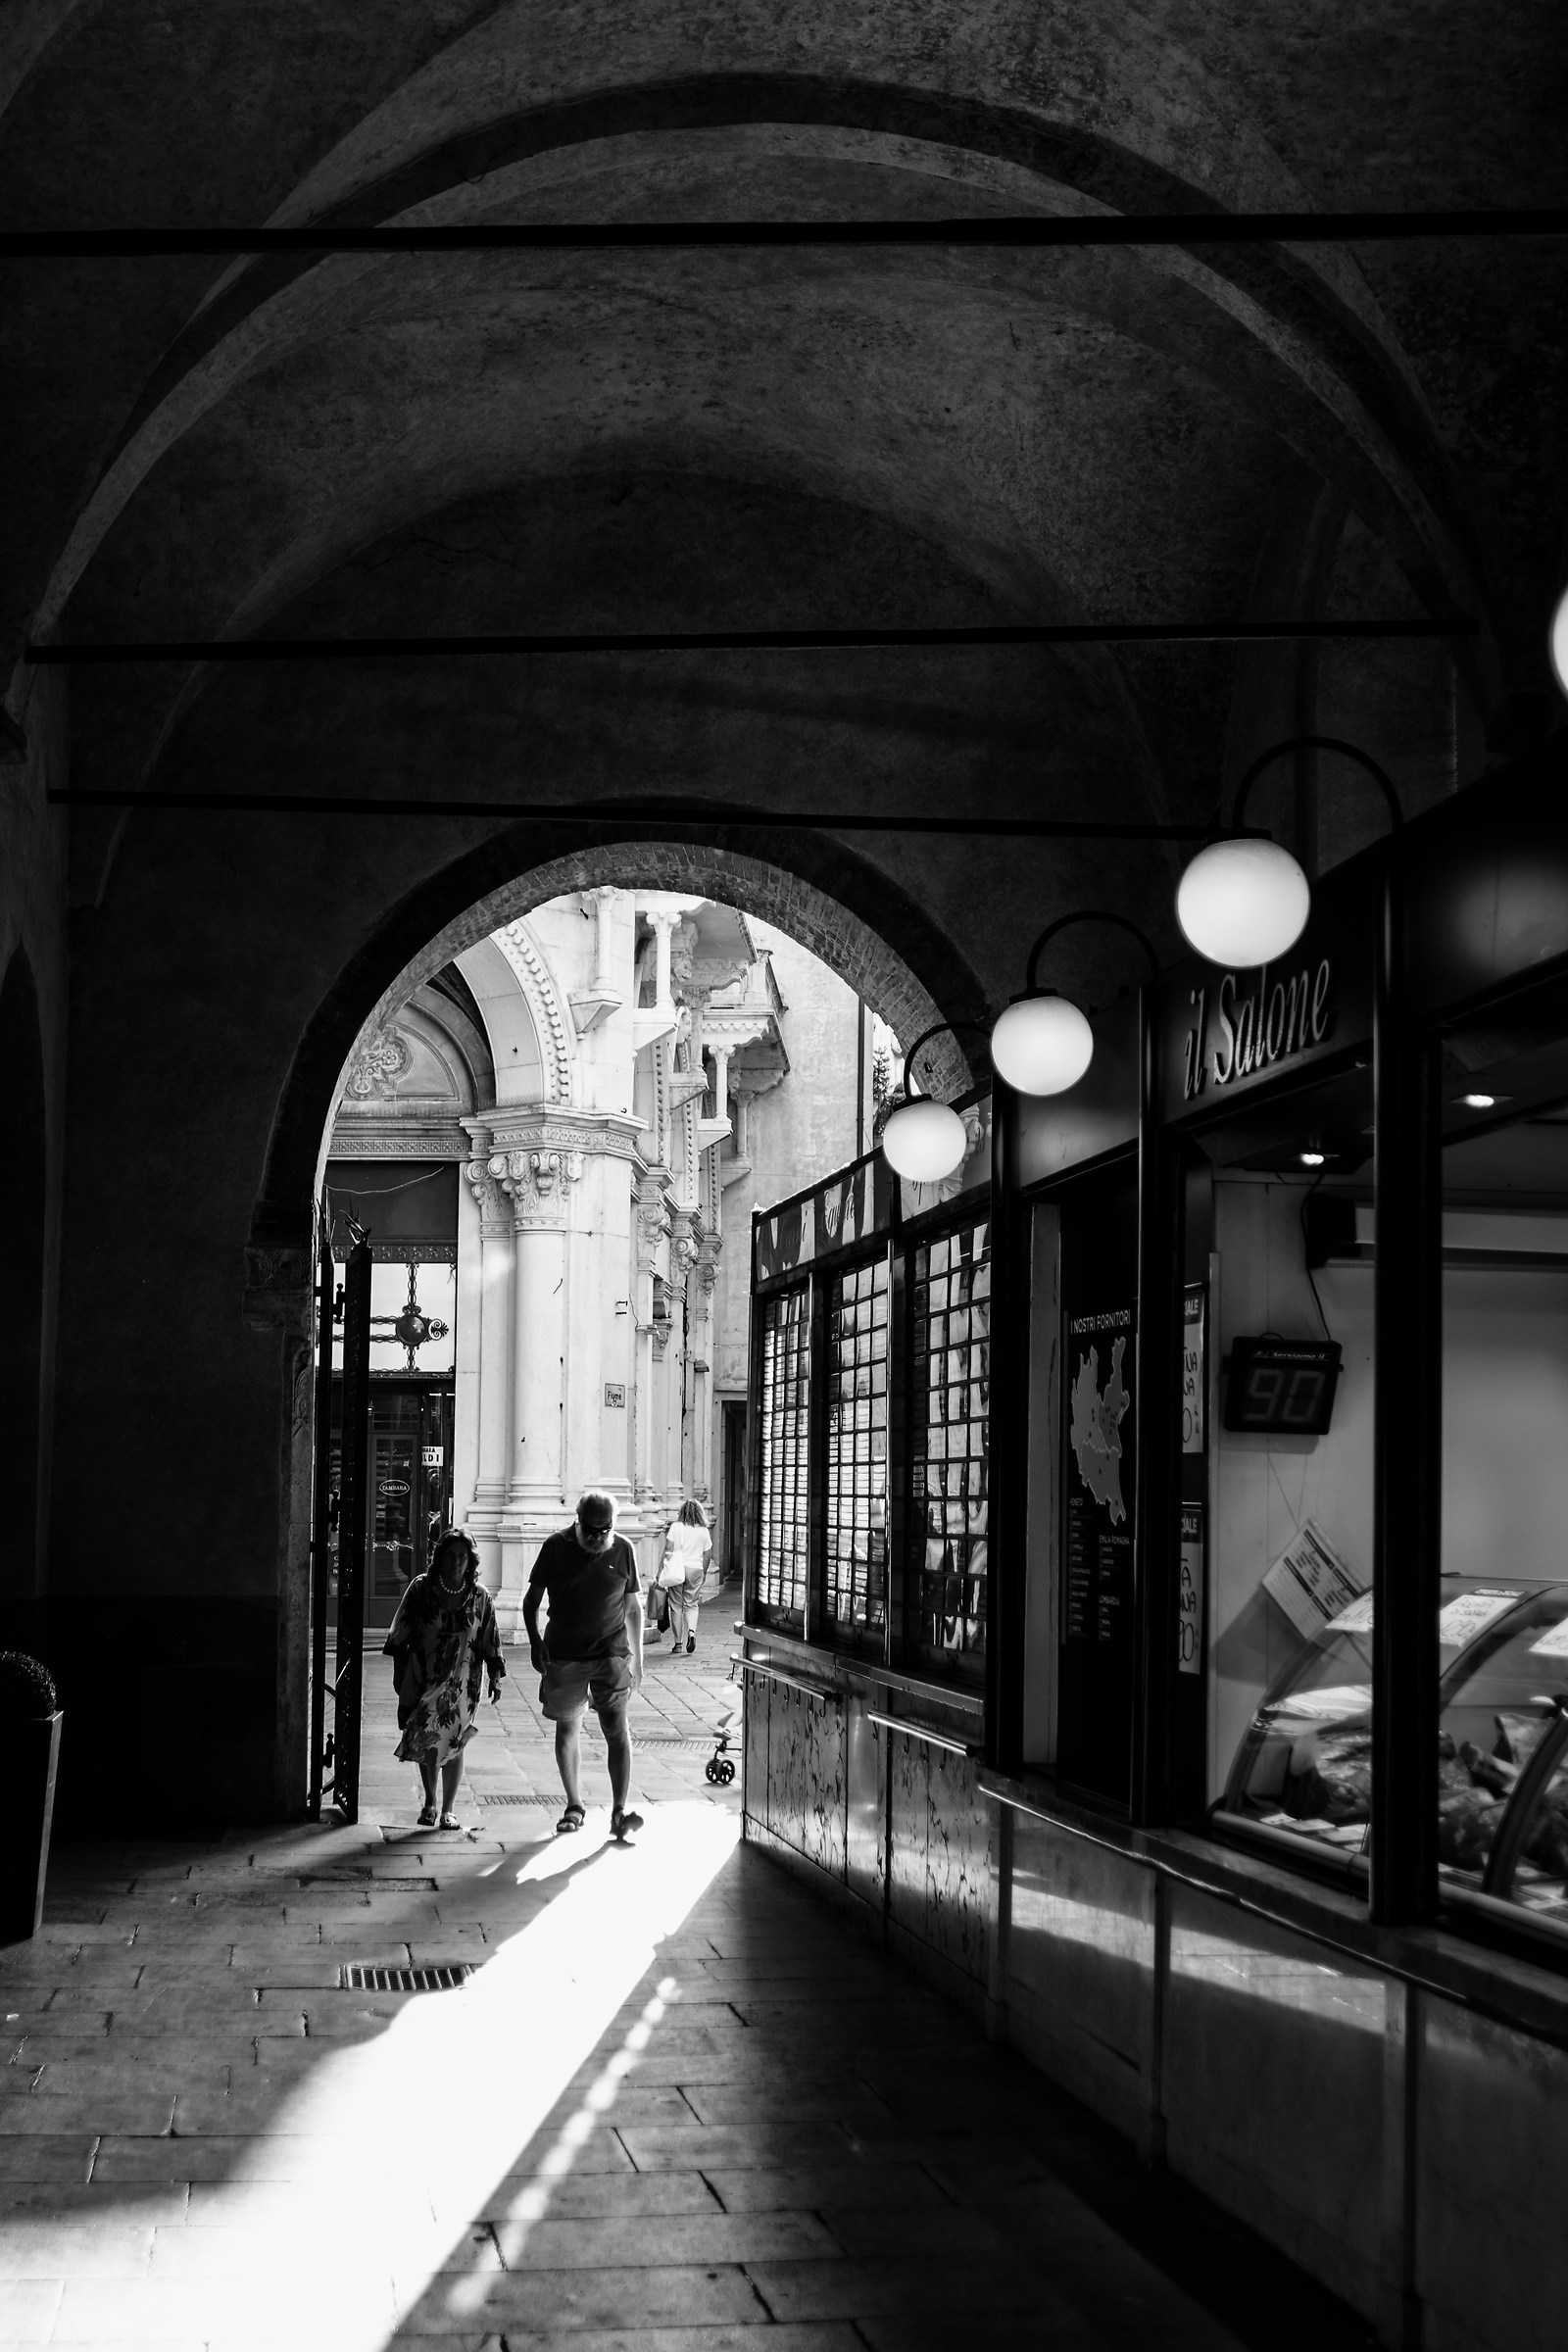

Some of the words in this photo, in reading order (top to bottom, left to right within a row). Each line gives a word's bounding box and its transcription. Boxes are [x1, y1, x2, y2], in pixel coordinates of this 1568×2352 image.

[1183, 988, 1206, 1101] il
[1213, 957, 1331, 1084] Salone
[1073, 1315, 1097, 1334] NOSTRI
[1097, 1308, 1131, 1330] FORNITORI
[1272, 1350, 1316, 1359] Serviamo
[1241, 1367, 1326, 1422] 90
[1069, 1497, 1084, 1507] VENETO
[1099, 1594, 1120, 1606] LOMBARDIA
